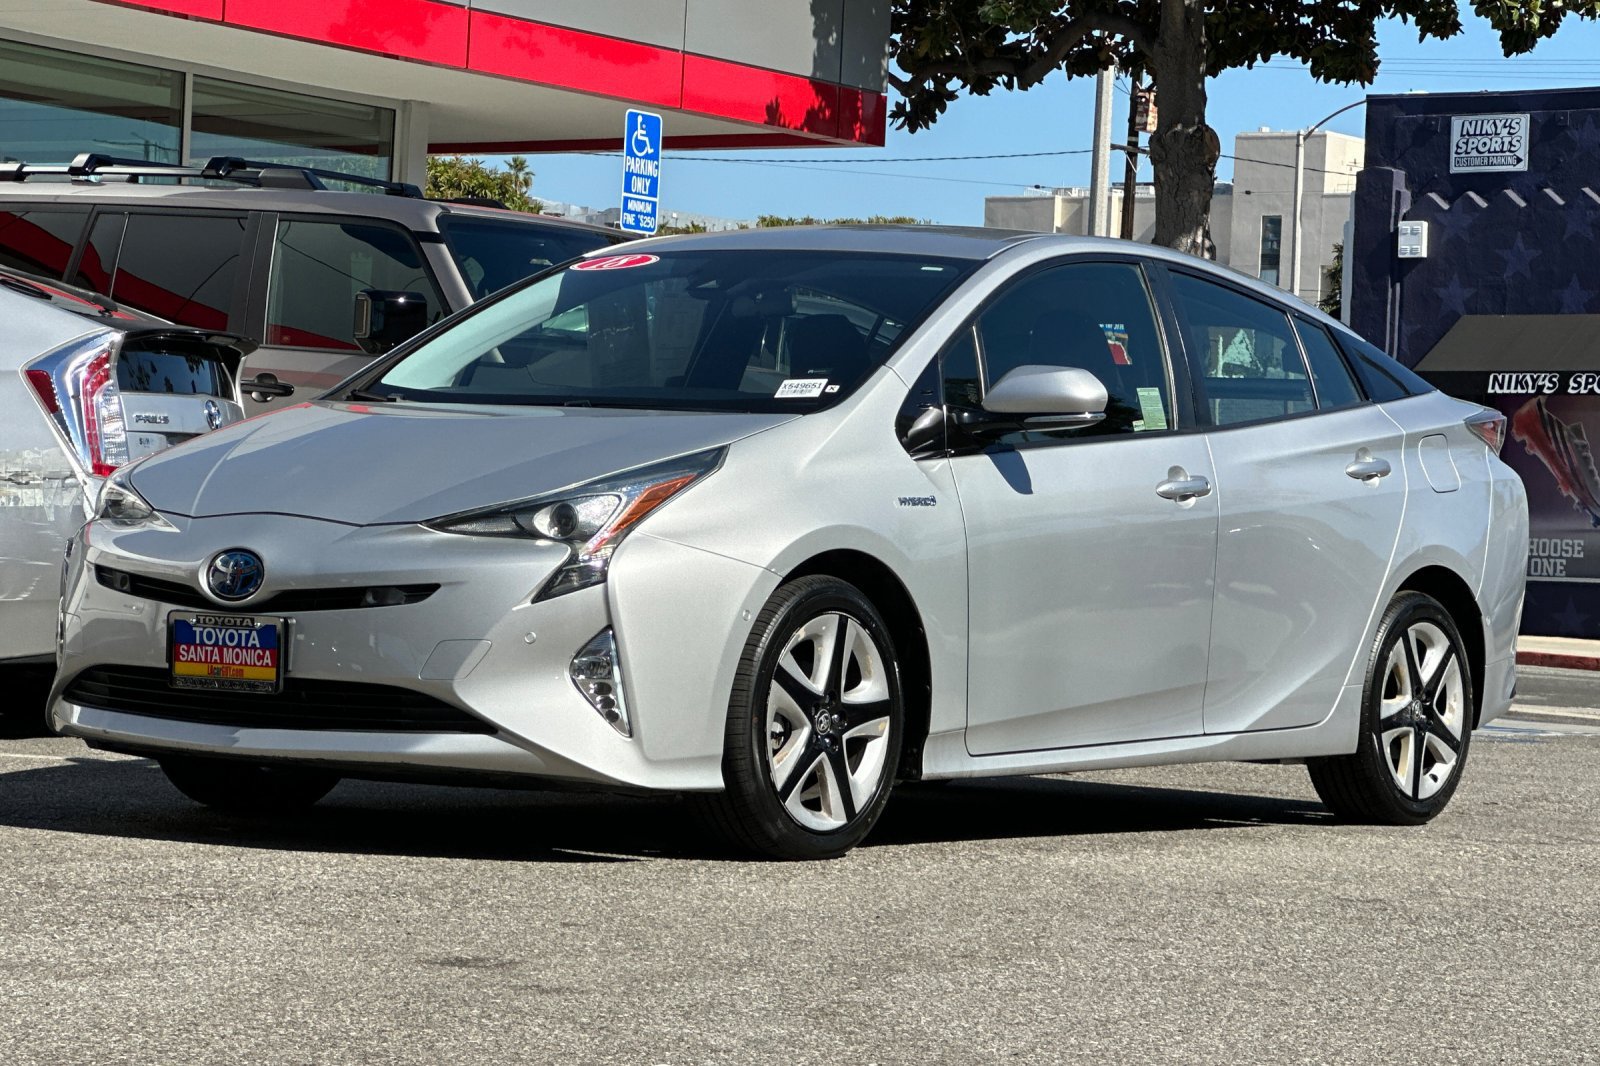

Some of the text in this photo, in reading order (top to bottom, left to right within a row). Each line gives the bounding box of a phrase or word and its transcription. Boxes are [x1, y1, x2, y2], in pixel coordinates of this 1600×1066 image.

[1460, 118, 1521, 137] NIKY'S
[1455, 136, 1522, 155] SPORTS
[626, 156, 658, 178] PARKING
[1455, 155, 1517, 167] CUSTOMER PARKING
[631, 175, 651, 195] ONLY
[627, 199, 652, 214] MINIMUM
[623, 213, 636, 226] FINE
[1487, 373, 1560, 394] NIKY'S
[1528, 538, 1584, 558] HOOSE
[1530, 557, 1567, 576] ONE
[197, 615, 253, 627] TOYOTA
[192, 627, 260, 648] TOYOTA
[180, 644, 272, 667] SANTA MONICA
